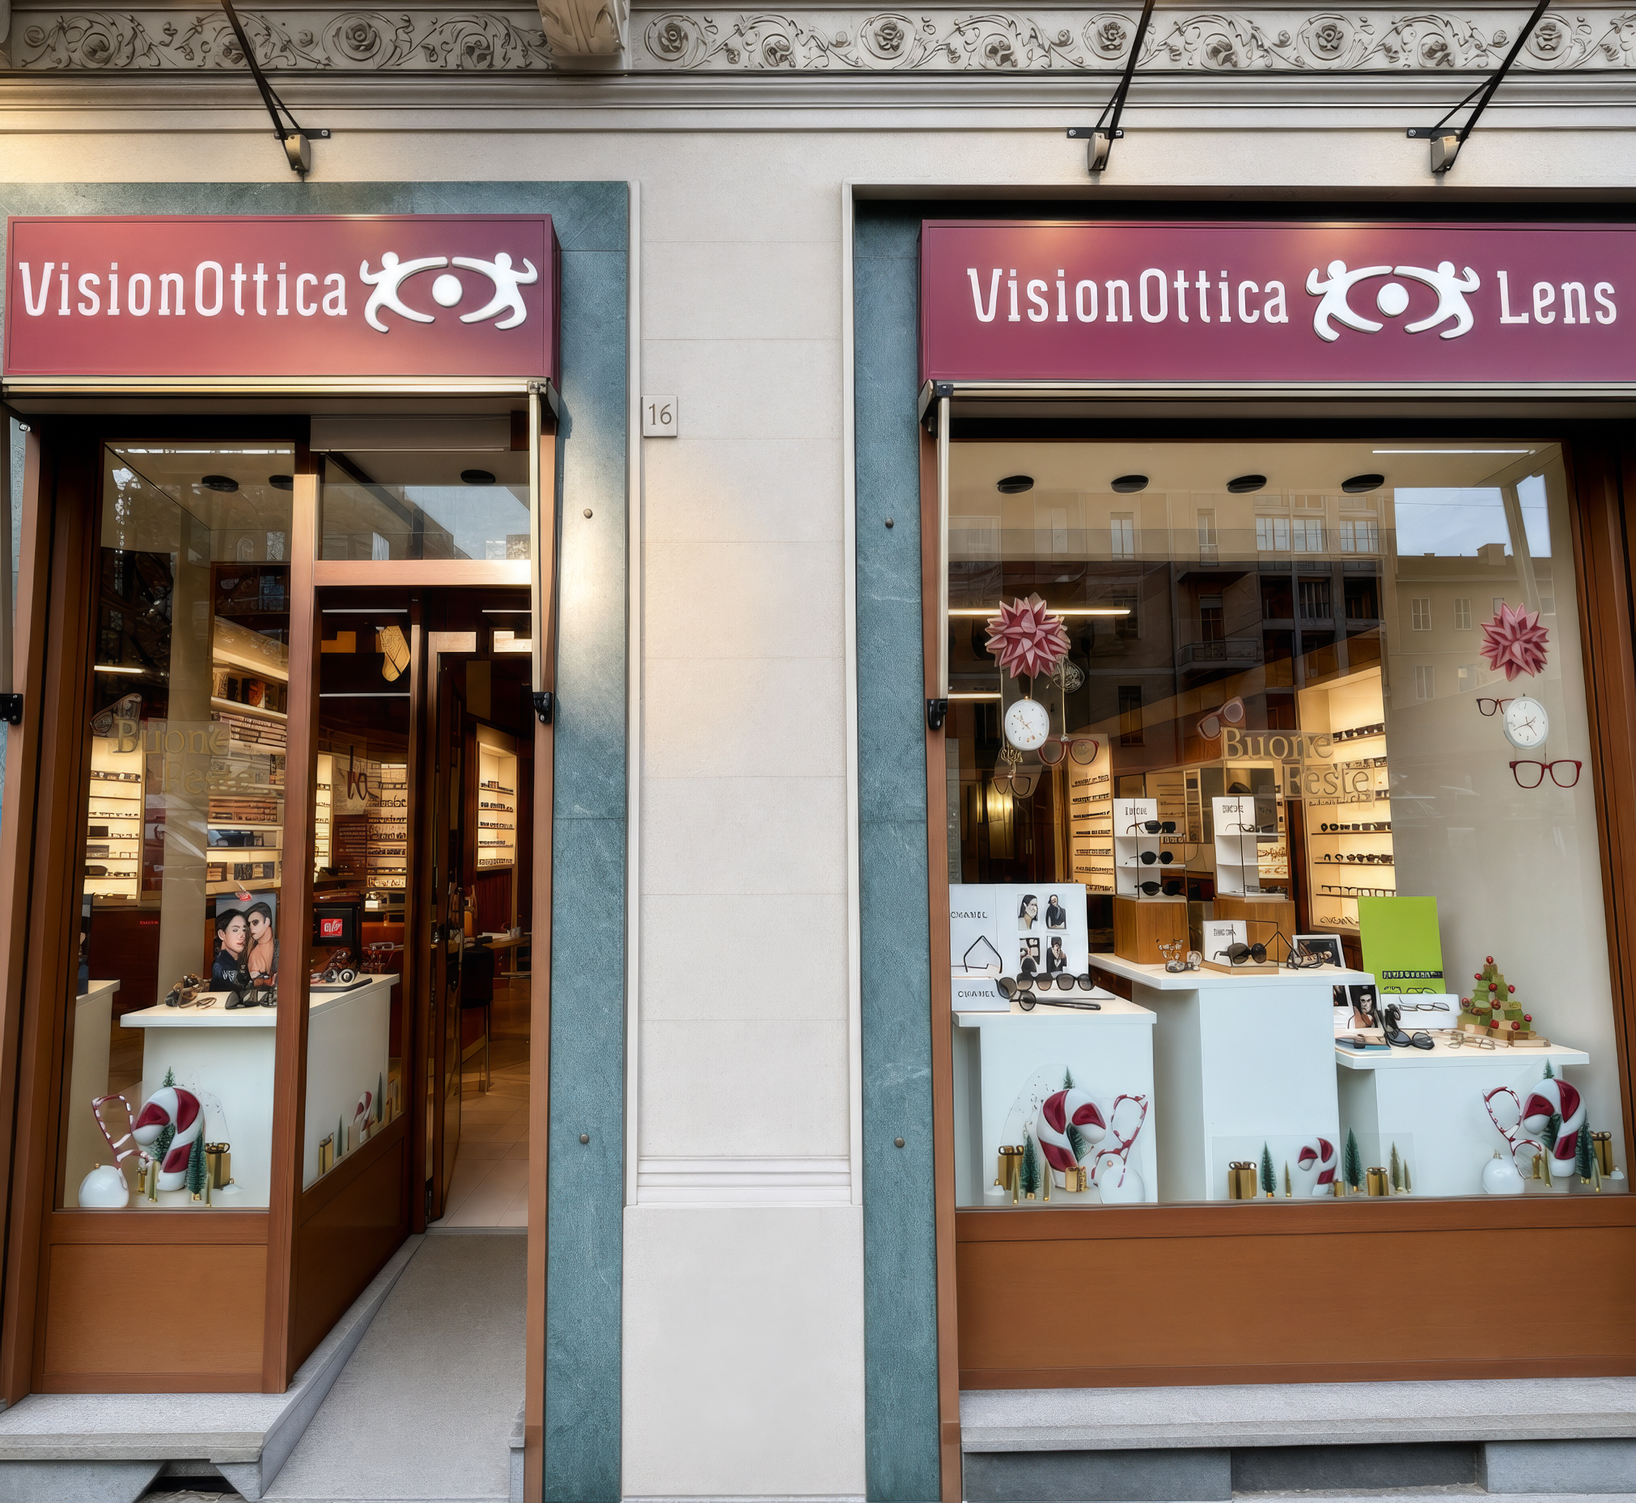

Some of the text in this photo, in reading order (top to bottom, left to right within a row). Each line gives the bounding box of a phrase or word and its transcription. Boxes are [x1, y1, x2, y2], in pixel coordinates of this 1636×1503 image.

[18, 260, 348, 317] VisionOttica
[966, 267, 1617, 325] VisionOttica Lens
[648, 403, 673, 426] 16
[1221, 727, 1335, 760] Buone
